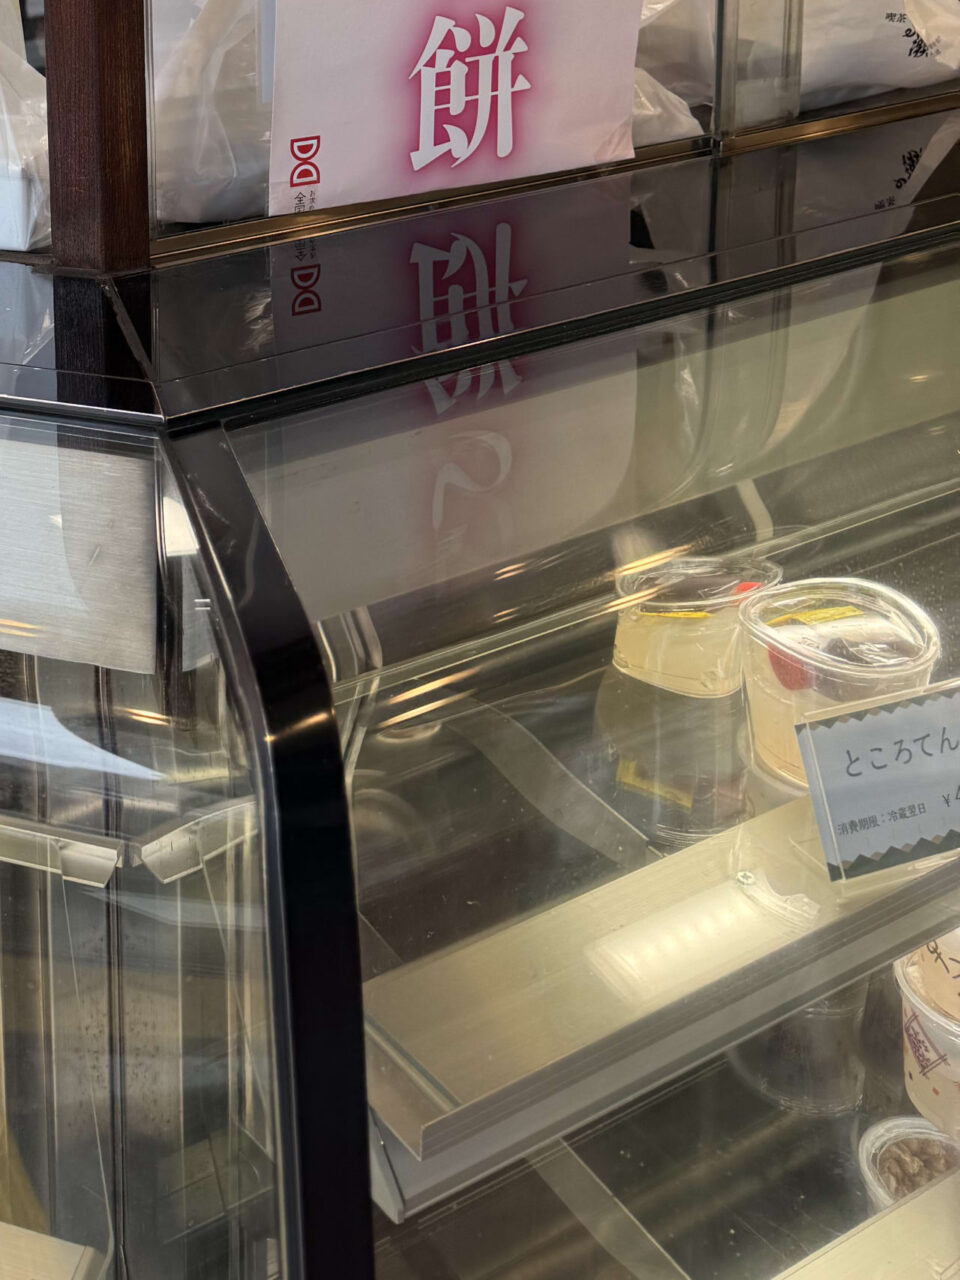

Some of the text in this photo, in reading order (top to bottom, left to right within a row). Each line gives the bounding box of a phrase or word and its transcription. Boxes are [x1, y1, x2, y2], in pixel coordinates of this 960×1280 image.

[845, 727, 960, 777] ところてん
